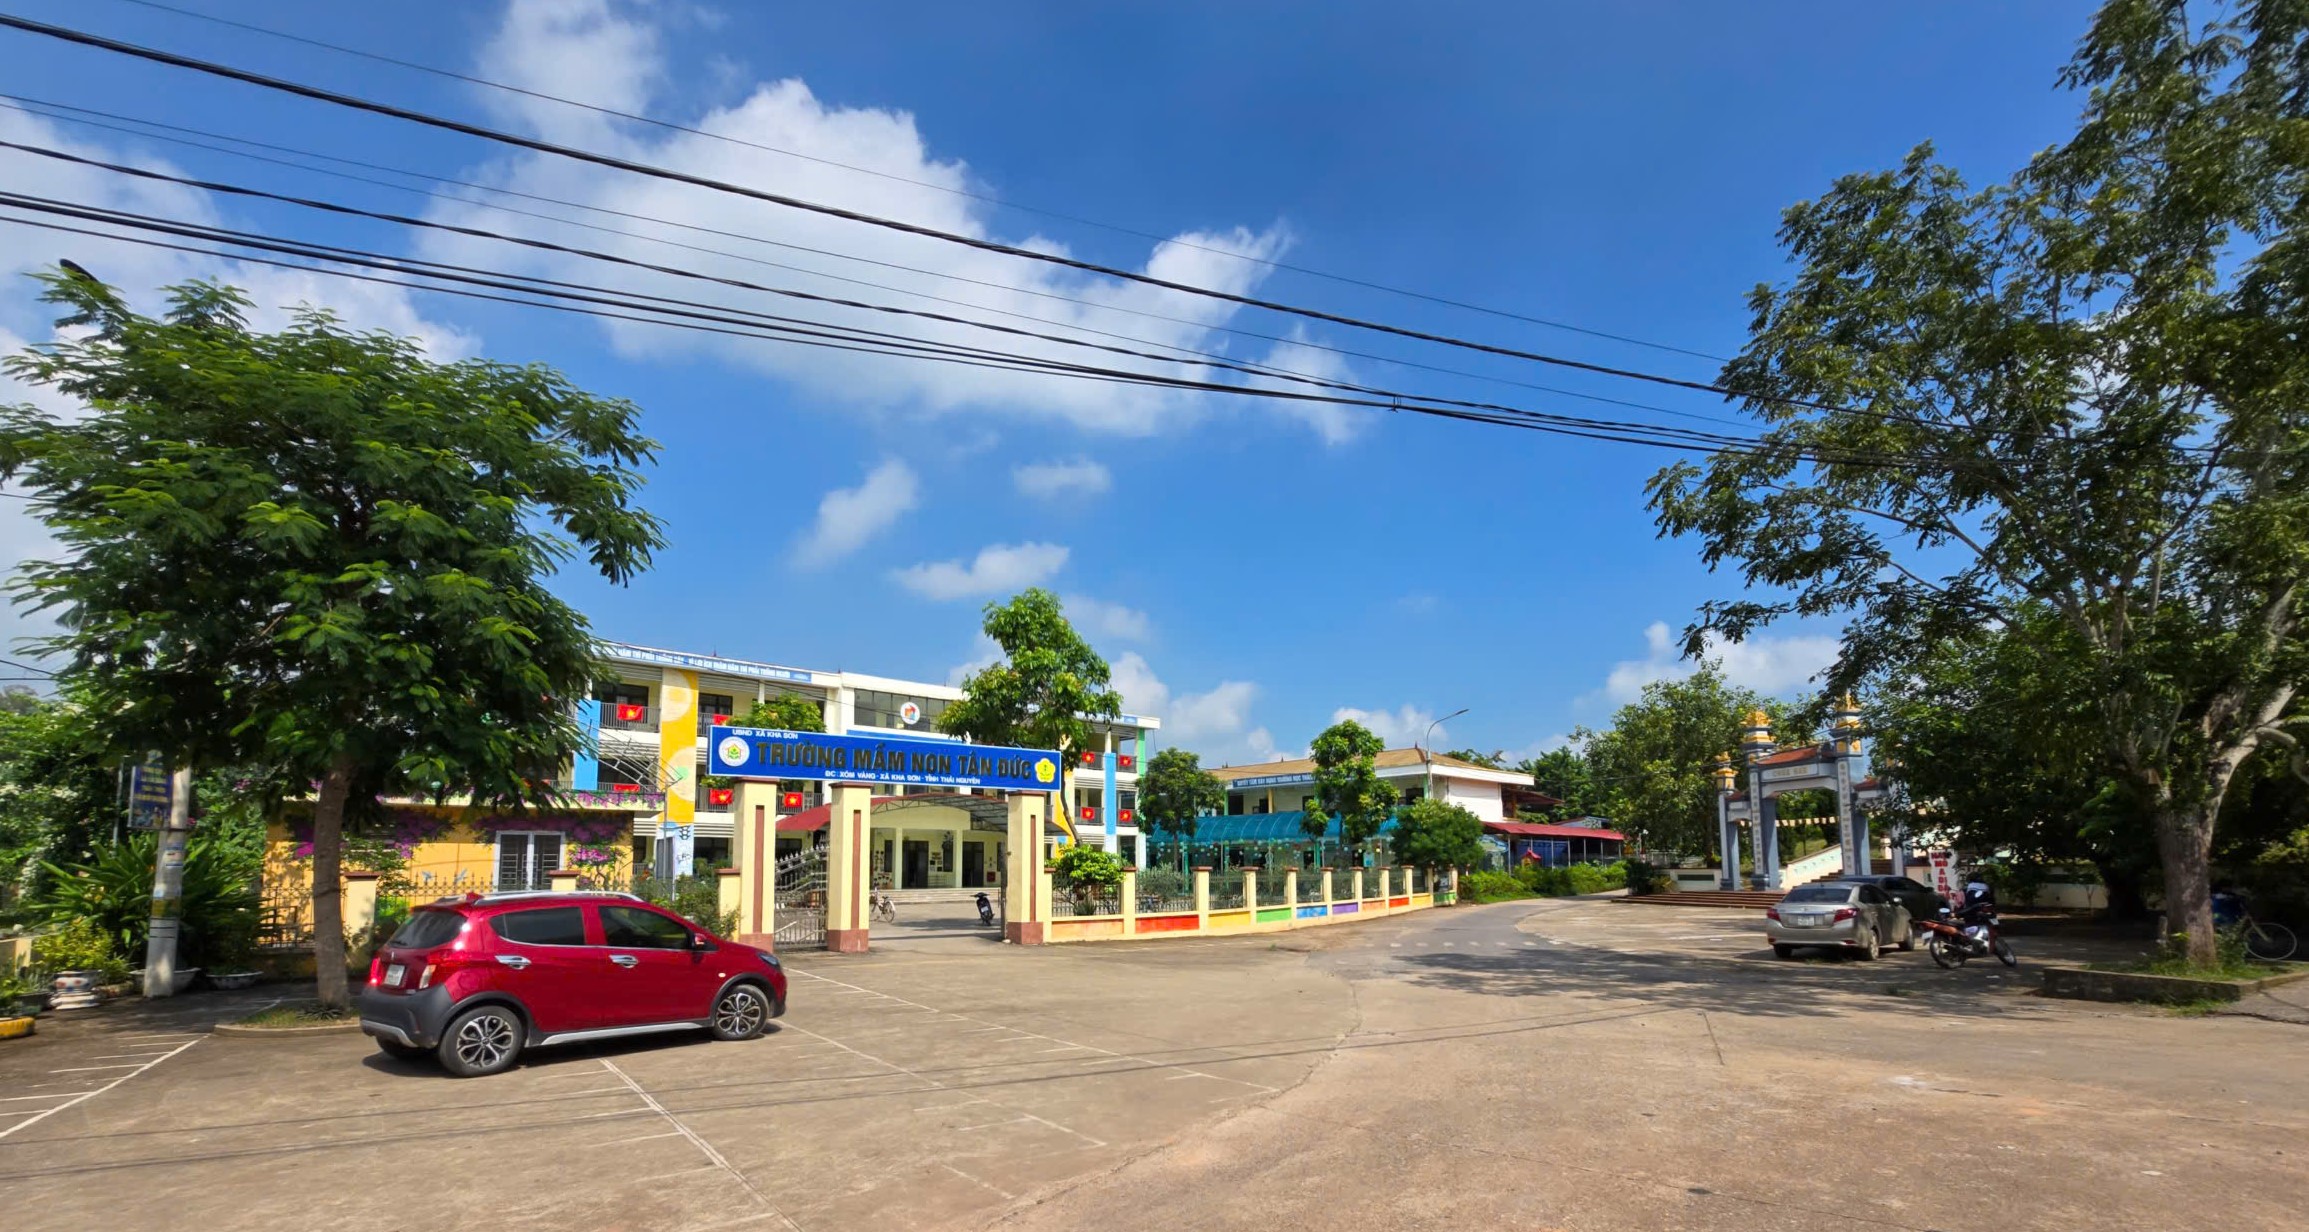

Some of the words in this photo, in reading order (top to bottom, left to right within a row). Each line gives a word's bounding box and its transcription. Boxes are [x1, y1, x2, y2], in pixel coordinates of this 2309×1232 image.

[732, 728, 753, 736] UBND
[755, 728, 766, 737] XÃ
[767, 730, 782, 739] KHA
[783, 731, 798, 739] SƠN
[756, 740, 847, 768] TRƯỜNG
[911, 752, 952, 775] NON
[957, 750, 992, 777] TÂN
[998, 754, 1032, 780] ĐỨC
[839, 771, 855, 779] XÓM
[857, 771, 876, 780] VÀNG
[880, 772, 890, 781] XÃ
[891, 774, 906, 782] KHA
[907, 774, 921, 782] SƠN
[925, 773, 939, 782] TỈNH
[940, 775, 955, 784] THÁI
[956, 776, 981, 785] NGUYÊN
